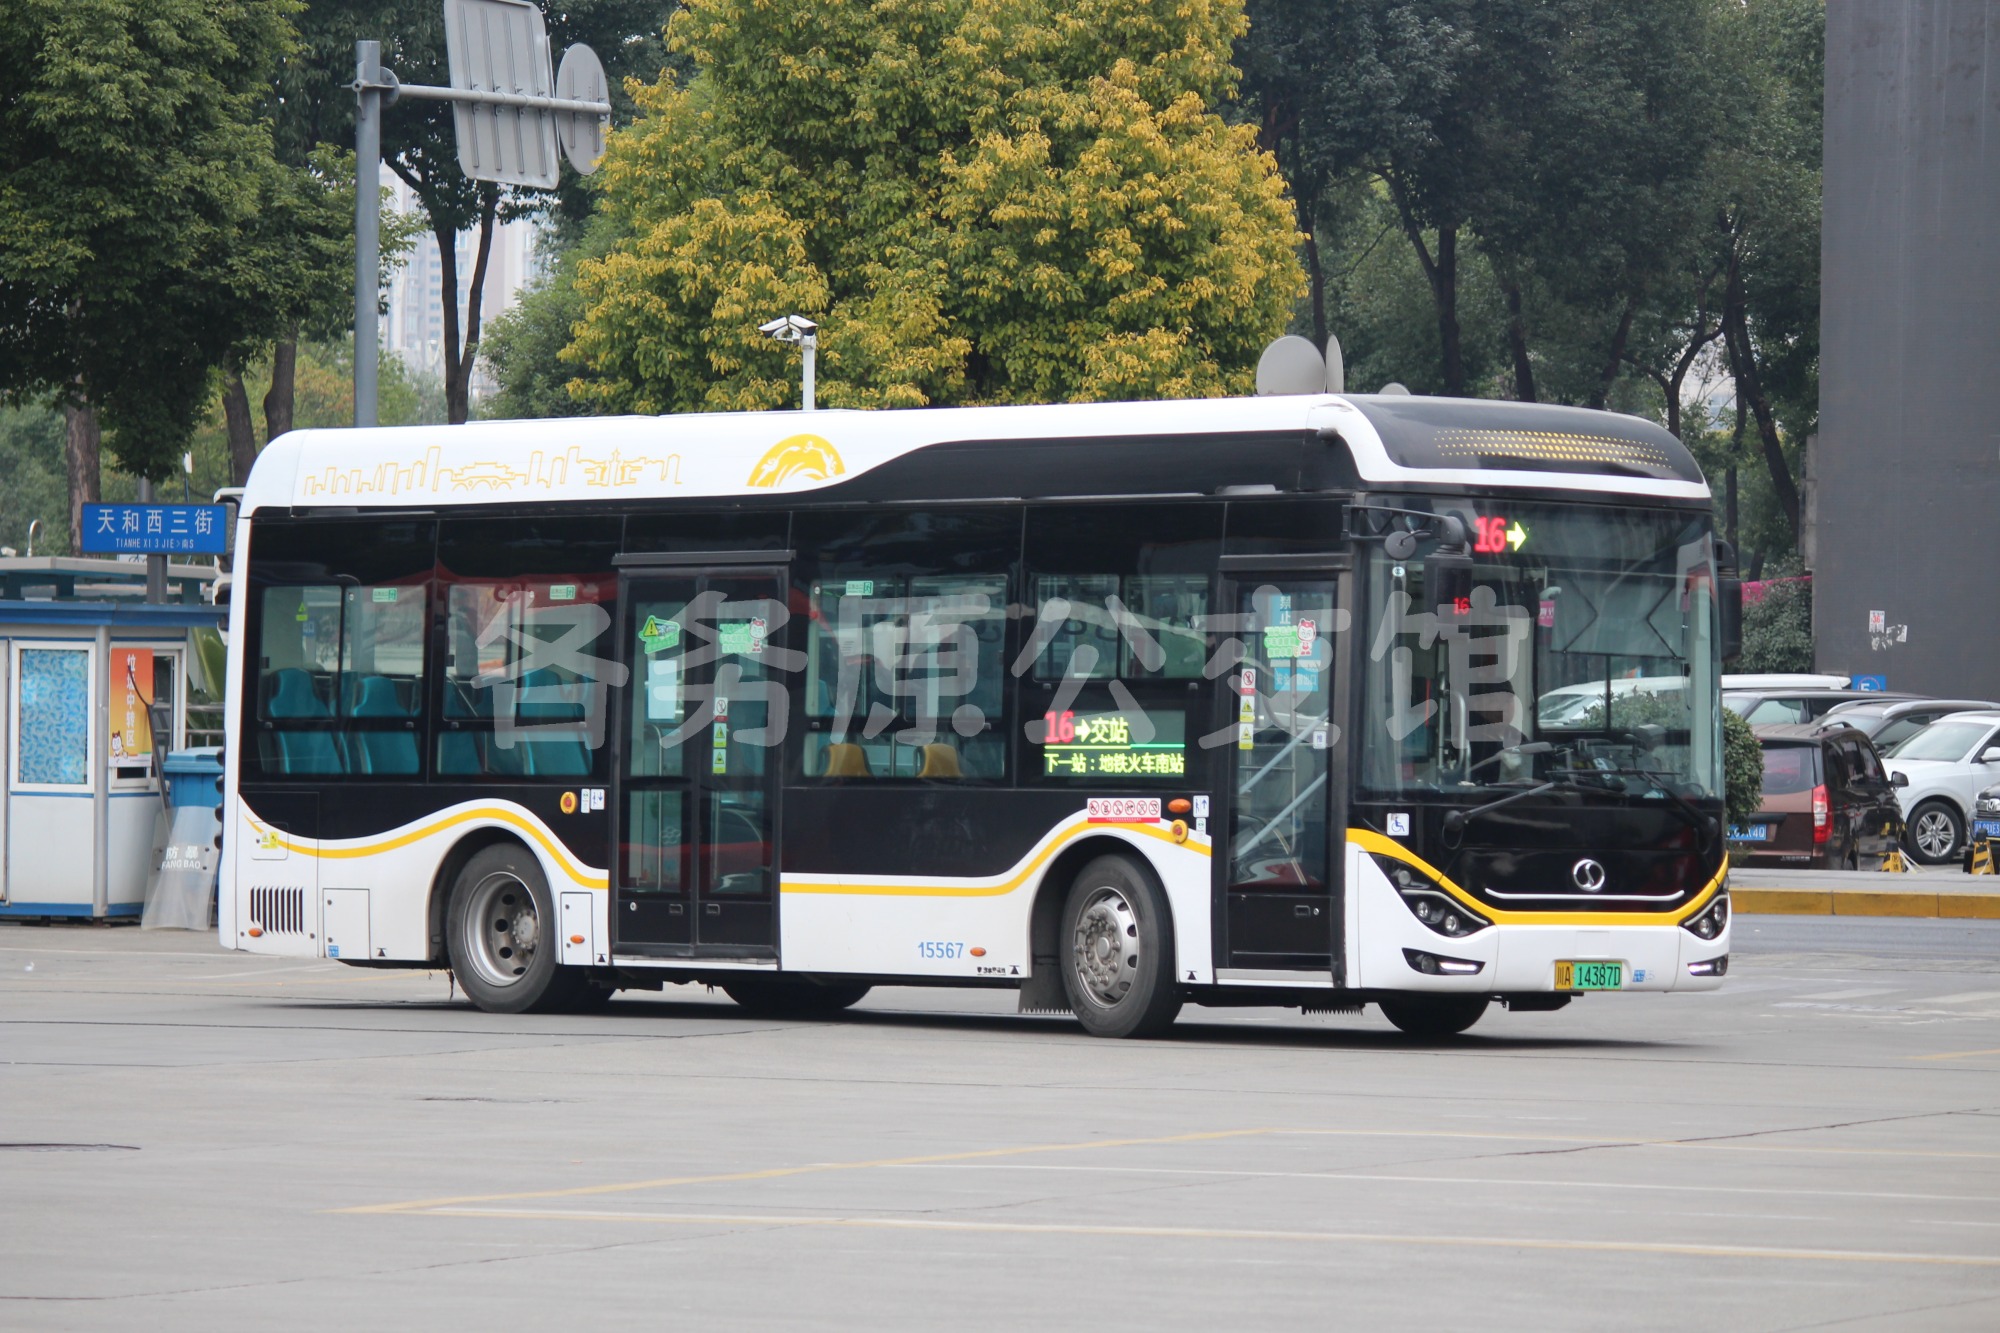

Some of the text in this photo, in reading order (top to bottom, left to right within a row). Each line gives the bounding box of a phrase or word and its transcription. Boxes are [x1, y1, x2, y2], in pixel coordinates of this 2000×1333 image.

[97, 508, 213, 535] 天和西三街
[116, 537, 141, 548] TIANHE
[143, 538, 151, 548] XI
[155, 538, 159, 549] 3
[161, 538, 174, 549] JIE
[1474, 516, 1507, 553] 16
[1453, 597, 1471, 615] 16
[1044, 710, 1129, 744] 16 交站
[161, 859, 201, 870] FANG BAO
[918, 941, 964, 958] 15567
